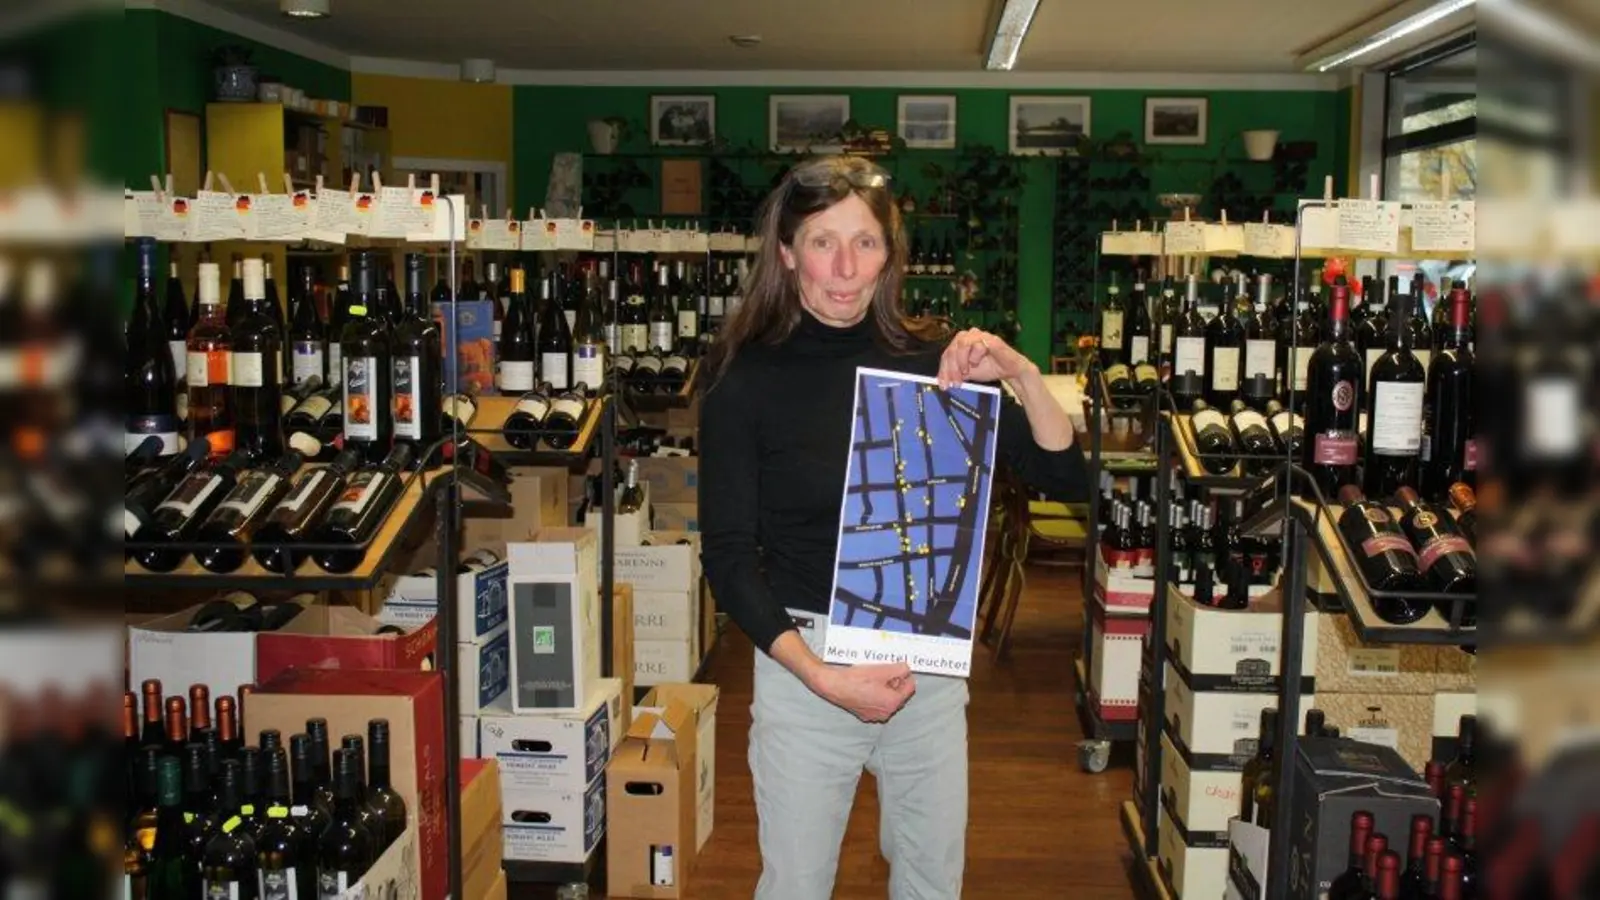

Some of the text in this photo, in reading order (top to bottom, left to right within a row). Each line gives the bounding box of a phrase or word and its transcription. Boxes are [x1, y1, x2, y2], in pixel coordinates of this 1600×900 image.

[827, 645, 968, 671] Mein Viertel leuchtet
